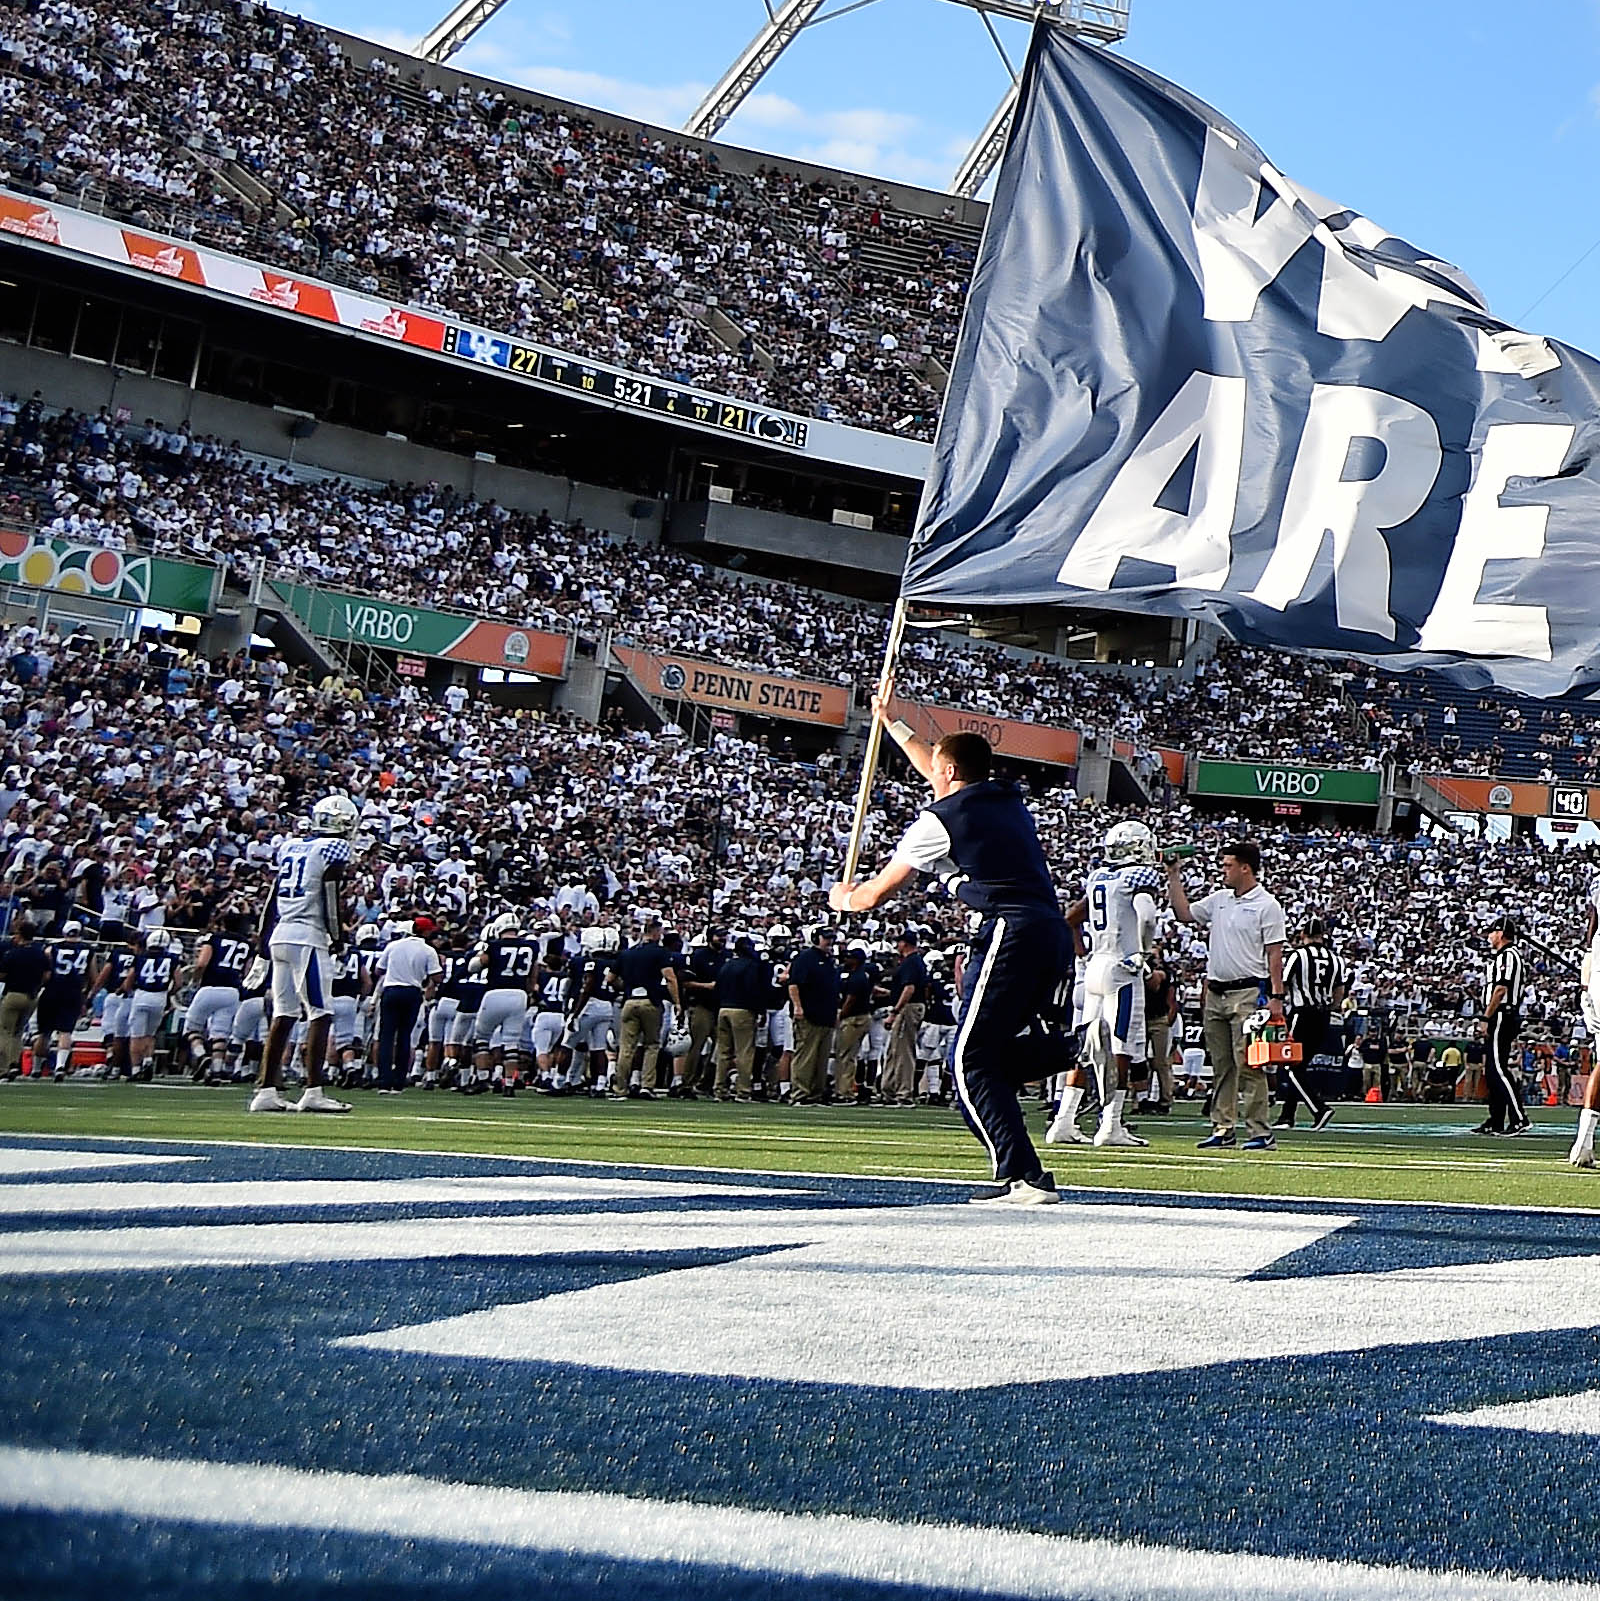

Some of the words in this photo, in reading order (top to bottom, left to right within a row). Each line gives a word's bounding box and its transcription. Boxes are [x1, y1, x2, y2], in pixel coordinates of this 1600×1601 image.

[512, 349, 537, 373] 27
[582, 376, 595, 389] 10
[614, 377, 652, 405] 5:21
[696, 407, 709, 419] 17
[723, 407, 744, 429] 21
[1057, 371, 1576, 662] ARE
[345, 603, 414, 643] VRBO
[693, 670, 753, 701] PENN
[759, 683, 823, 714] STATE
[1255, 769, 1320, 795] VRBO
[1558, 792, 1583, 814] 40
[278, 856, 308, 898] 21
[1092, 885, 1107, 931] 9
[56, 949, 90, 976] 54
[218, 939, 249, 970] 72
[500, 947, 534, 977] 73
[140, 958, 171, 984] 44
[1314, 959, 1329, 983] F
[1185, 1026, 1203, 1043] 27
[1281, 1045, 1292, 1059] G
